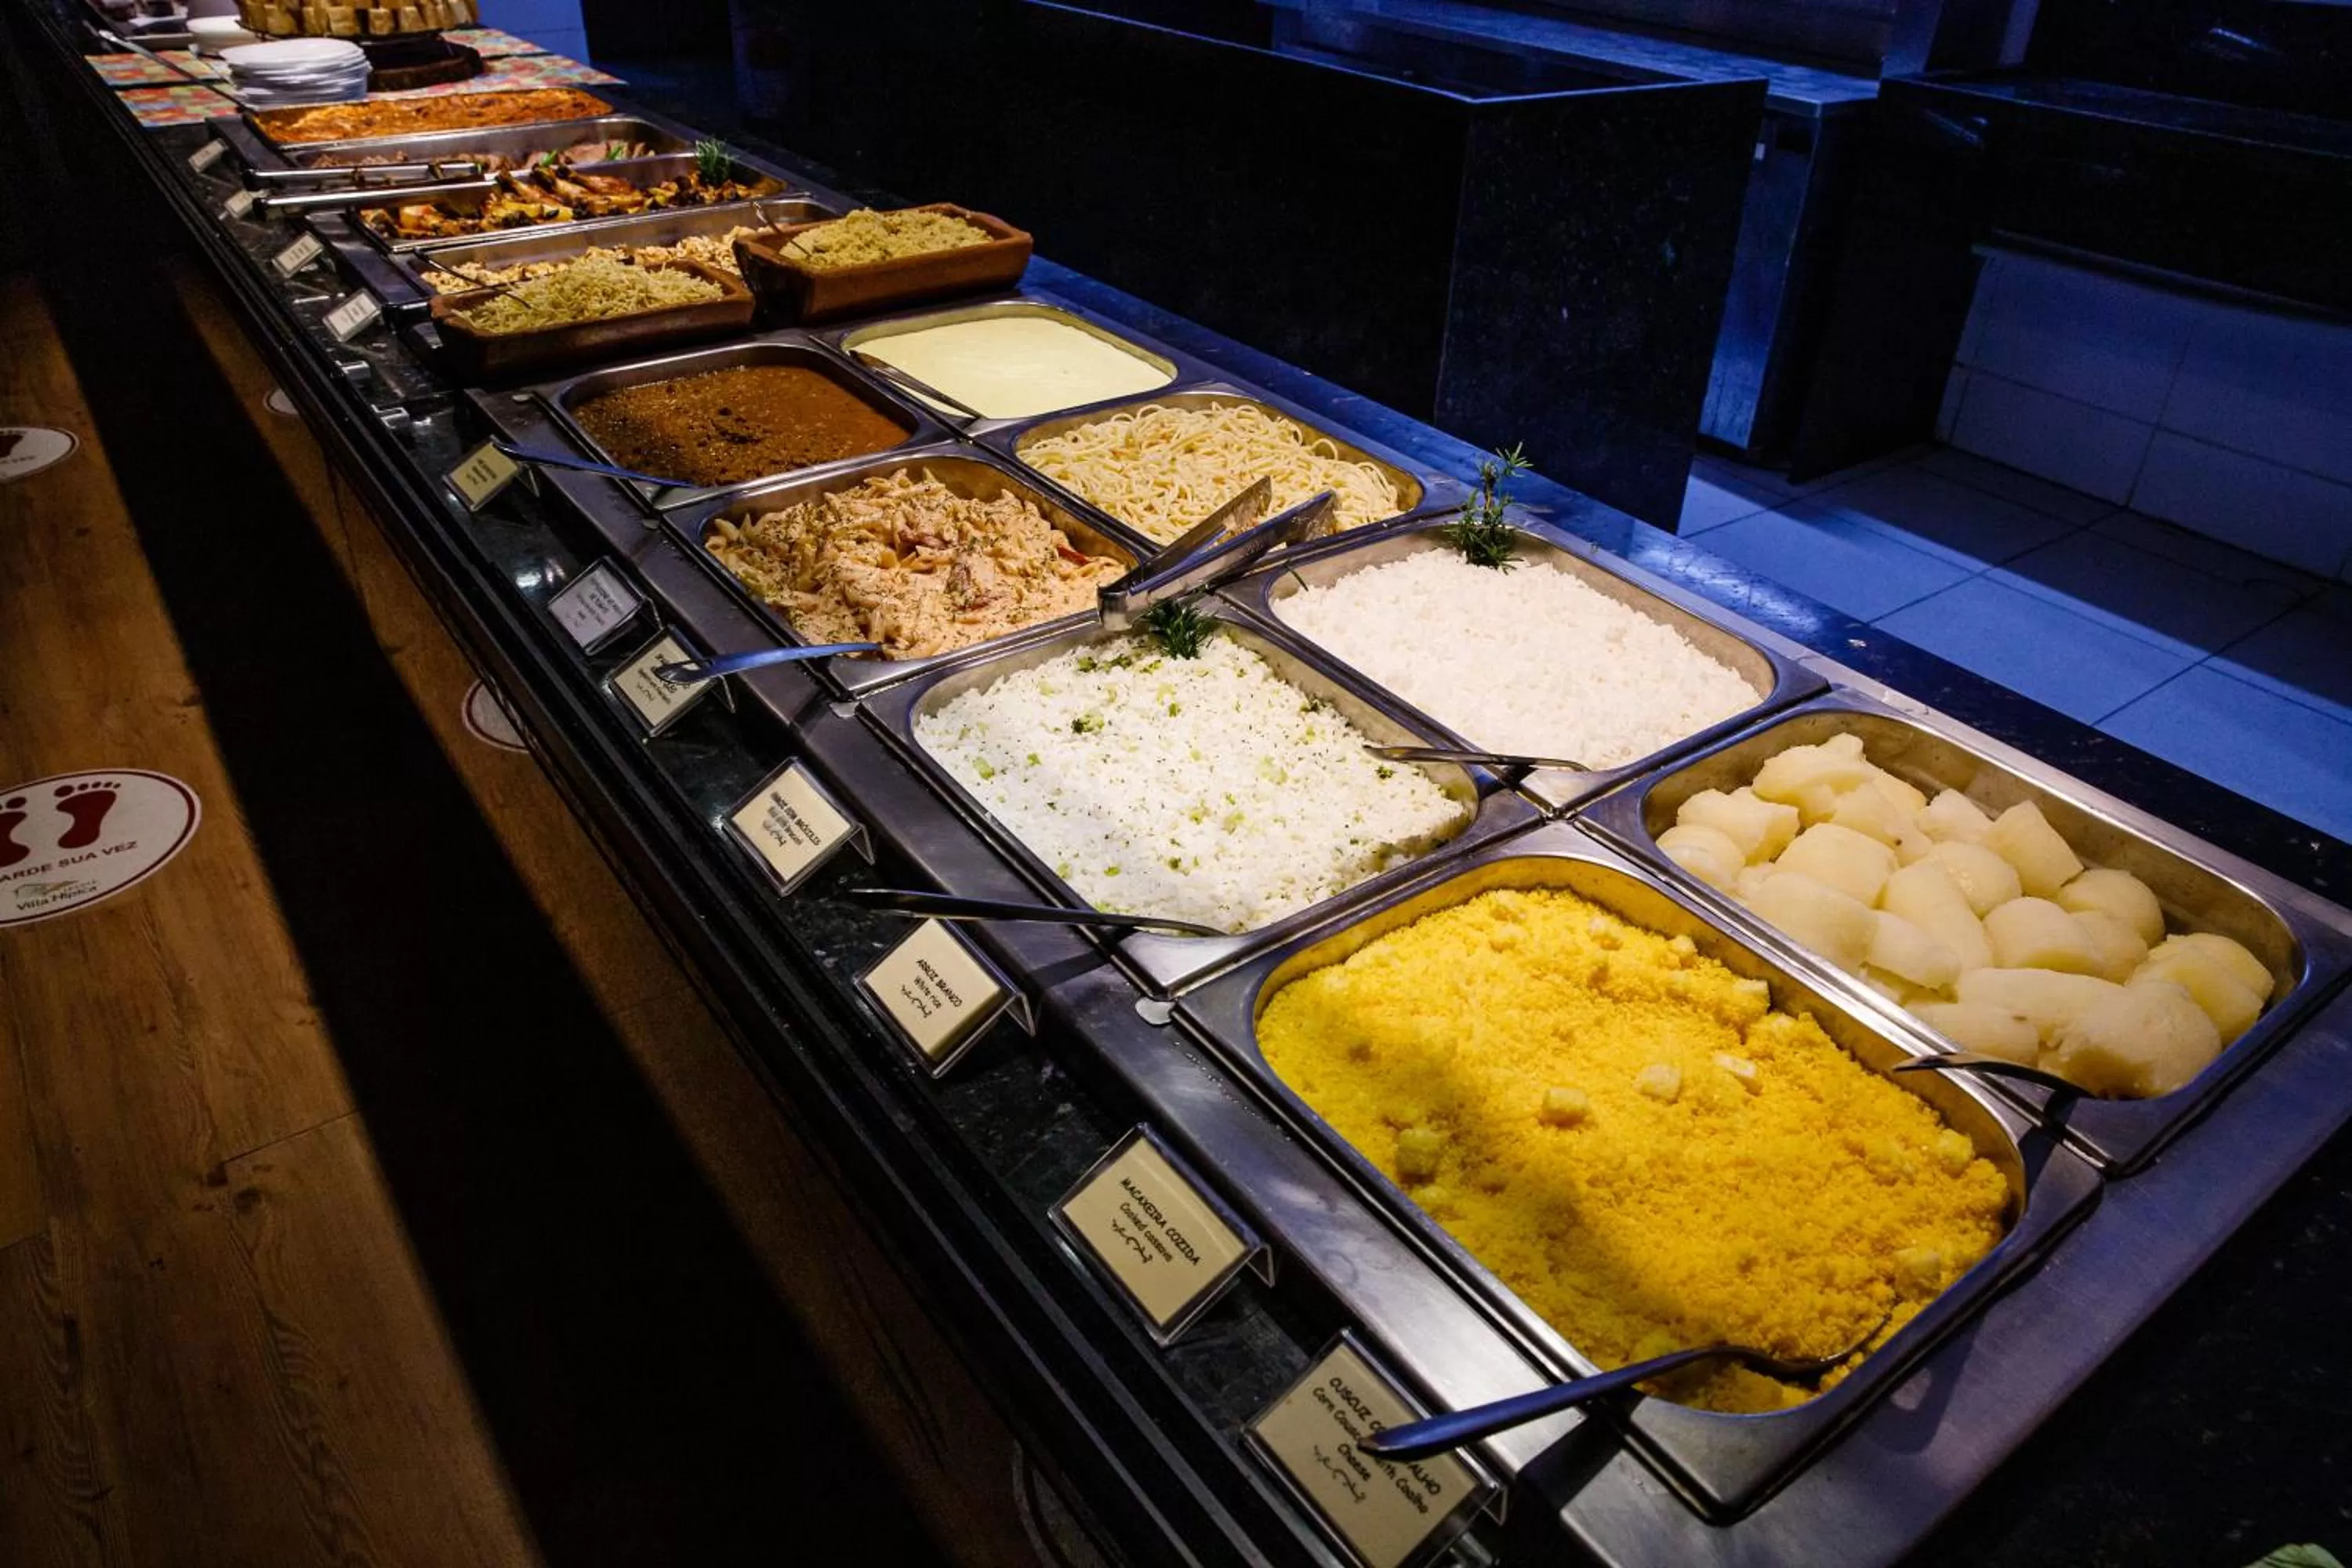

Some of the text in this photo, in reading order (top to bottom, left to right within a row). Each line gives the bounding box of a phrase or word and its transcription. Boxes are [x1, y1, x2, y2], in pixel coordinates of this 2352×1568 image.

[58, 852, 97, 868] SUA
[102, 840, 138, 855] VEZ
[16, 898, 49, 911] Villa
[916, 960, 962, 1007] ARROZ BRANCO
[1120, 1202, 1149, 1232] Cooked
[1120, 1178, 1200, 1265] MACAXEIRA COZIDA
[1313, 1387, 1334, 1413] Corn
[1330, 1377, 1372, 1421] CUSCUZ
[1338, 1443, 1371, 1482] Cheese
